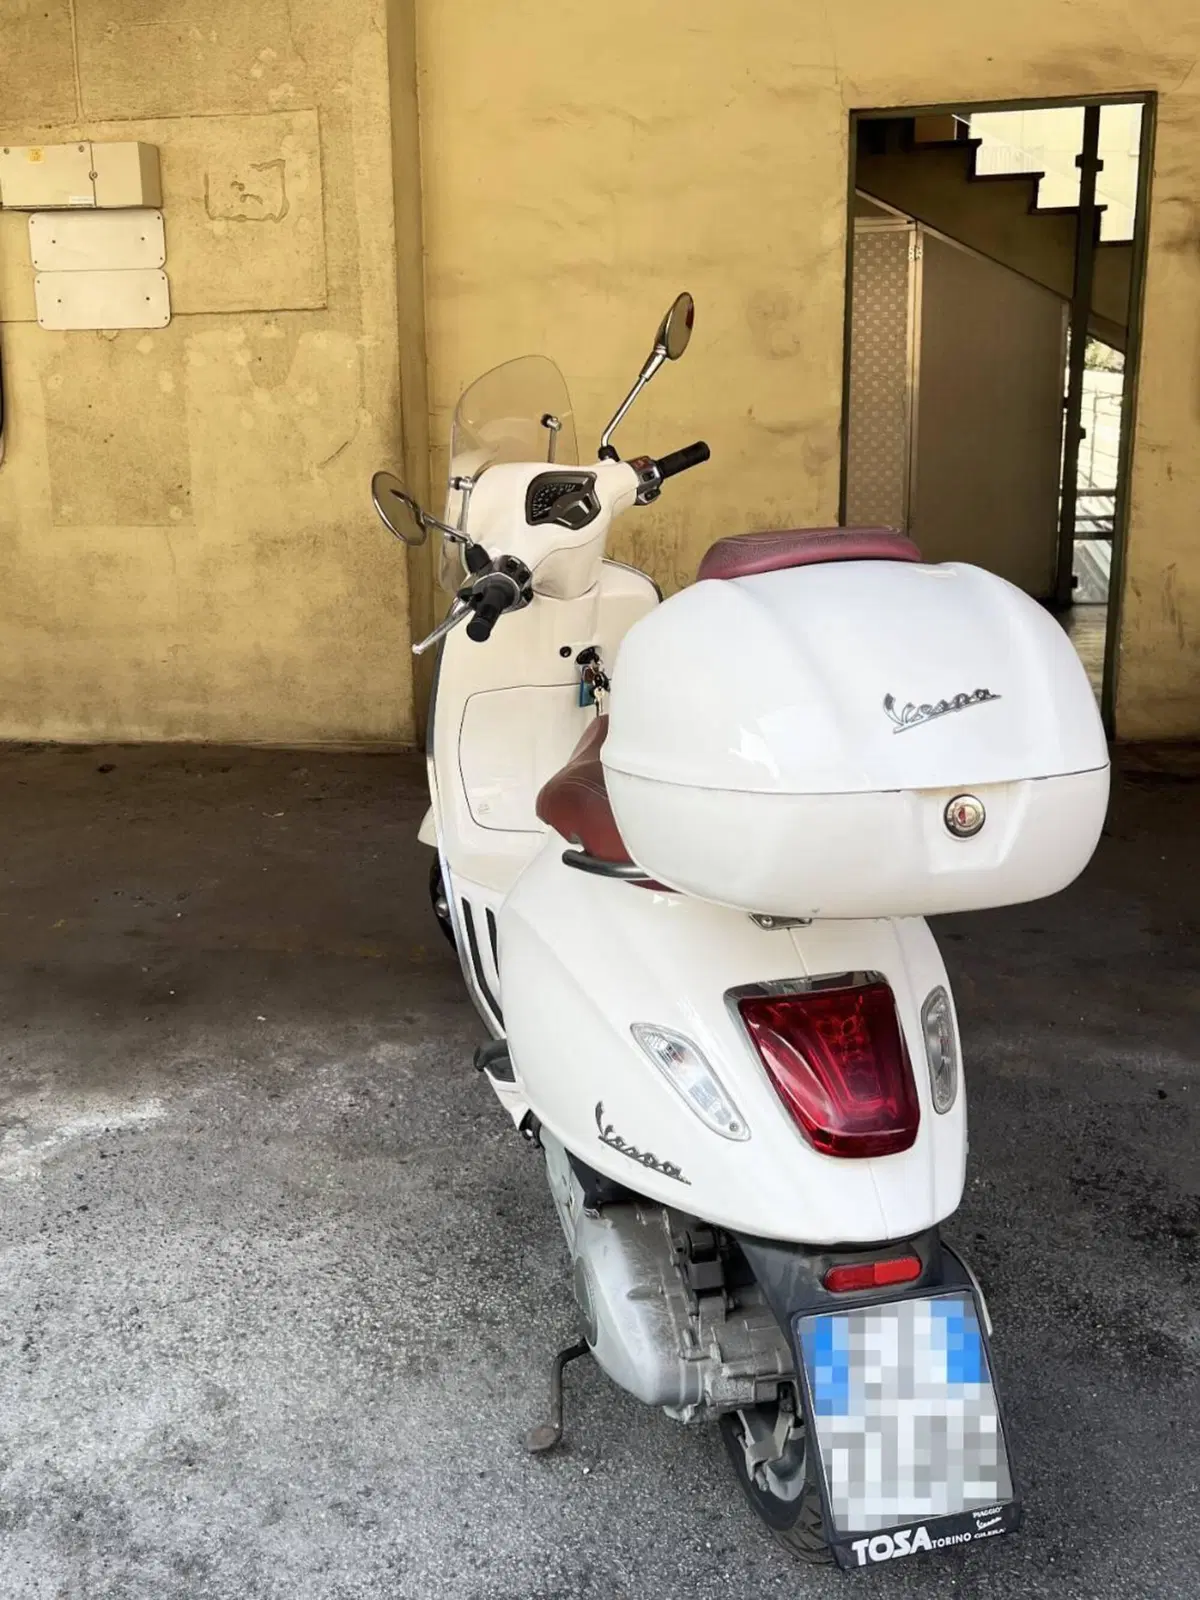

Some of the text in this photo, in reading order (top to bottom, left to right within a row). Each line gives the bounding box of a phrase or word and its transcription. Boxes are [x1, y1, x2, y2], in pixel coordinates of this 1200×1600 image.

[883, 688, 1002, 735] Vespa
[594, 1100, 692, 1186] Vespa
[851, 1526, 972, 1566] TOSA TORINO
